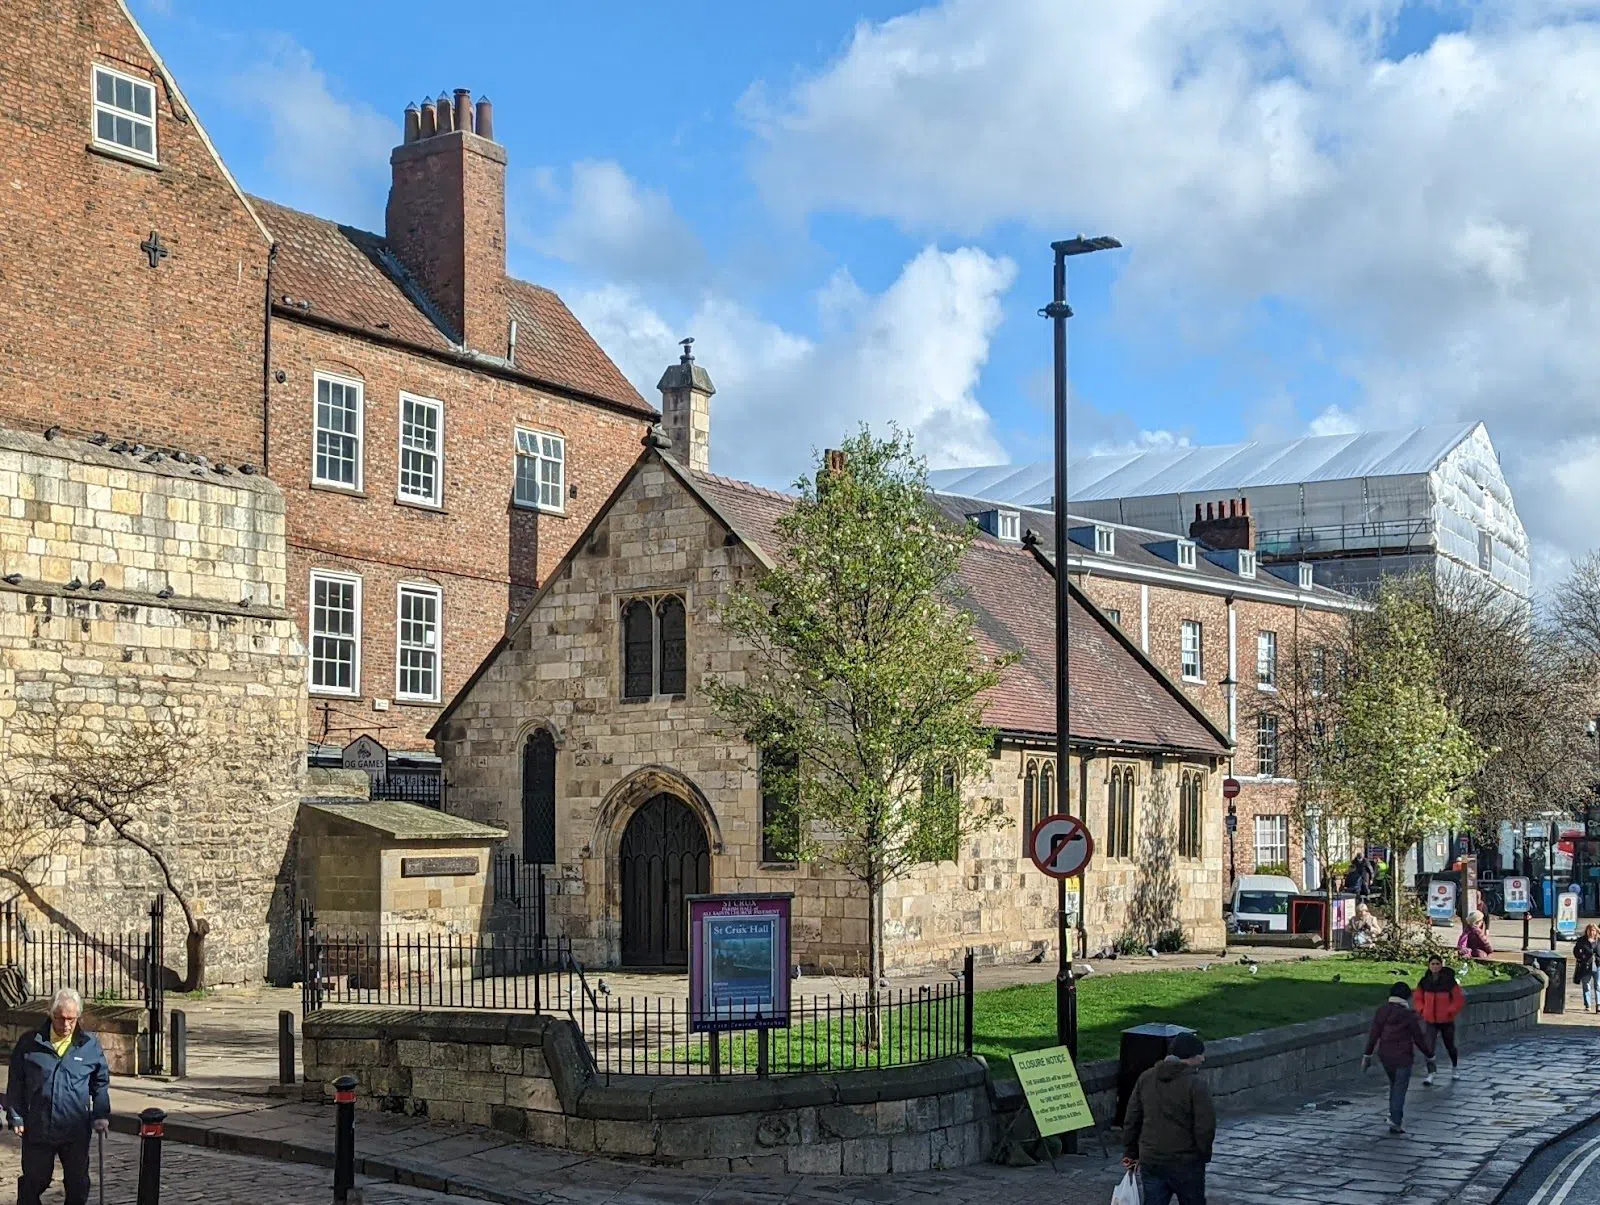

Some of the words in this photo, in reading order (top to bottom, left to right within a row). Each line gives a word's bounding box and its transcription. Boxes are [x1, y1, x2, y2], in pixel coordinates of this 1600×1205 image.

[344, 760, 356, 768] OG
[357, 759, 385, 768] GAMES
[733, 899, 757, 907] CRUX
[713, 926, 723, 935] St
[724, 925, 748, 935] Crux
[749, 924, 769, 933] Hall
[1018, 1058, 1046, 1069] CLOSURE
[1046, 1054, 1067, 1066] NOTICE
